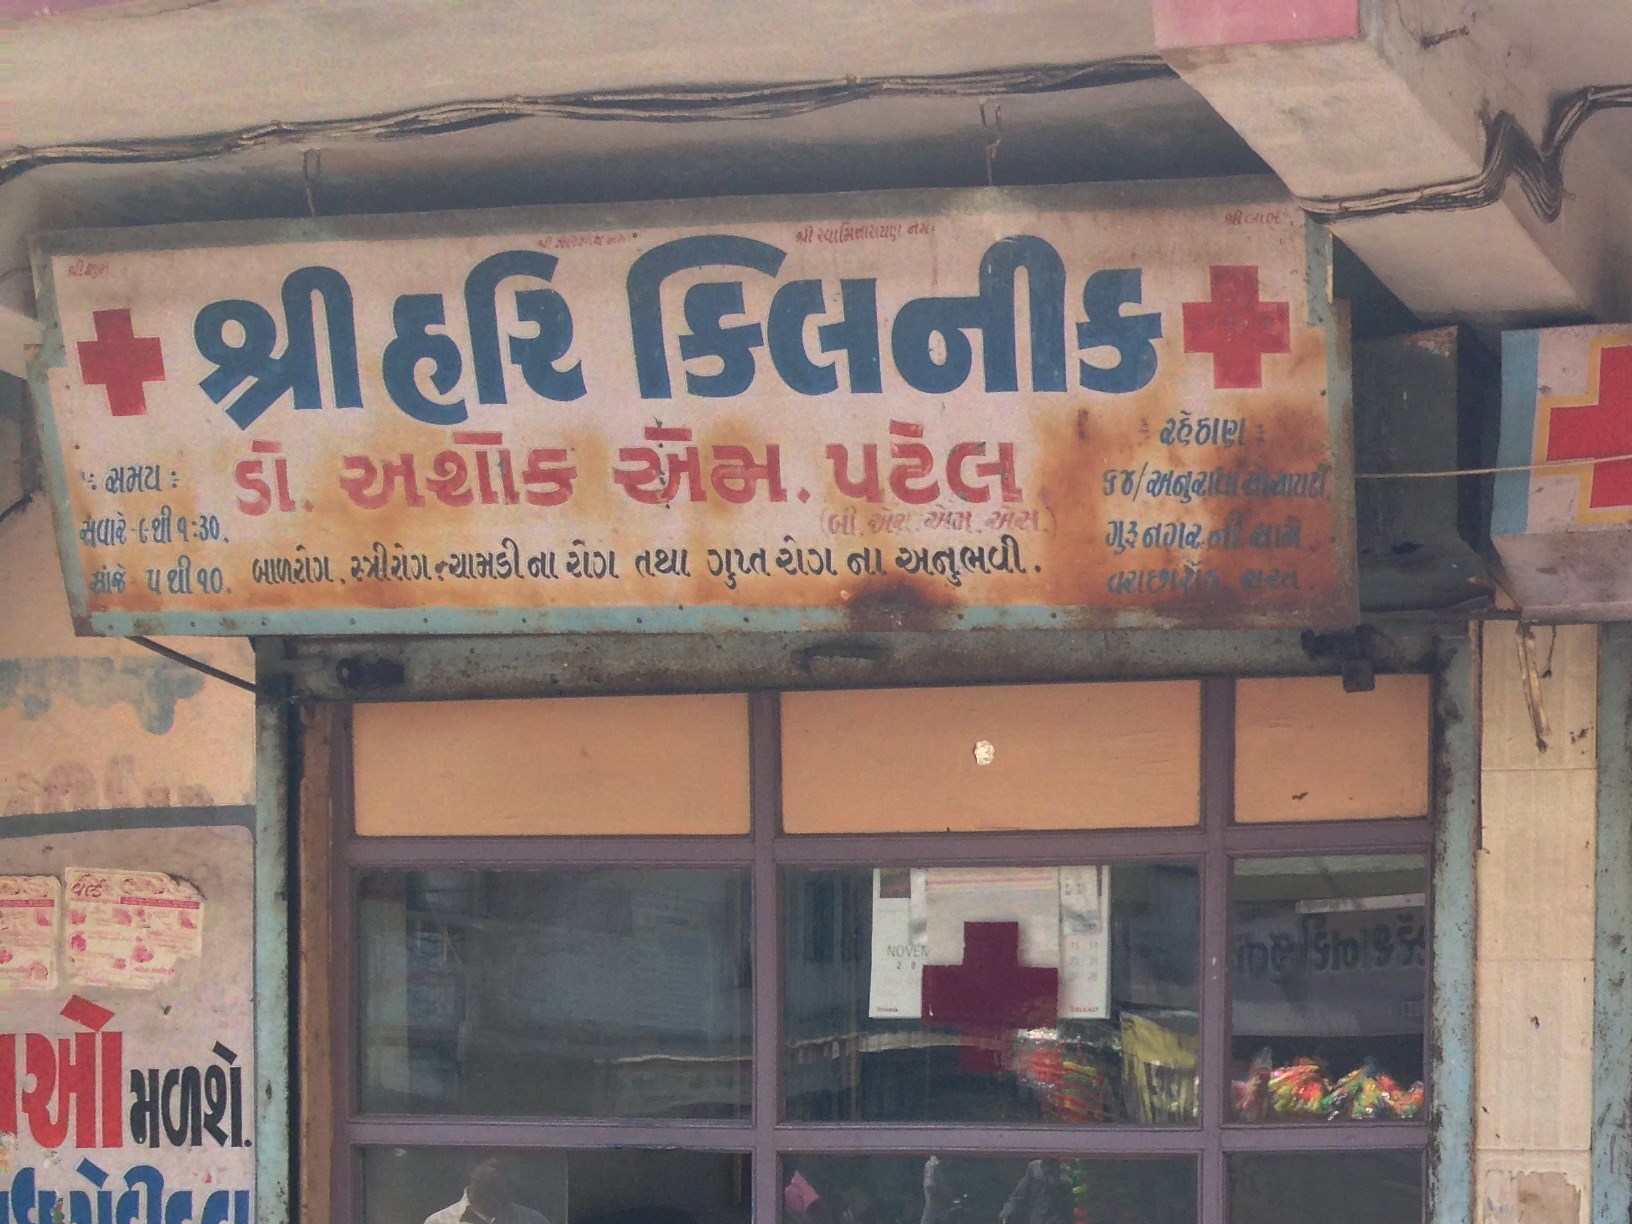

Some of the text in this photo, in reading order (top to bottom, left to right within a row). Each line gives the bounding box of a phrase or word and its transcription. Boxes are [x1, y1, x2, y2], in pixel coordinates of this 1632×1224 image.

[194, 265, 364, 430] શ્રી
[381, 250, 588, 426] હરિ
[826, 421, 1024, 504] પટેલ
[167, 555, 192, 595] થી
[565, 539, 620, 579] રોગ
[634, 547, 692, 578] તથા
[707, 547, 771, 590] ગુપ્ત
[775, 535, 838, 577] રોગ
[847, 546, 887, 576] ના
